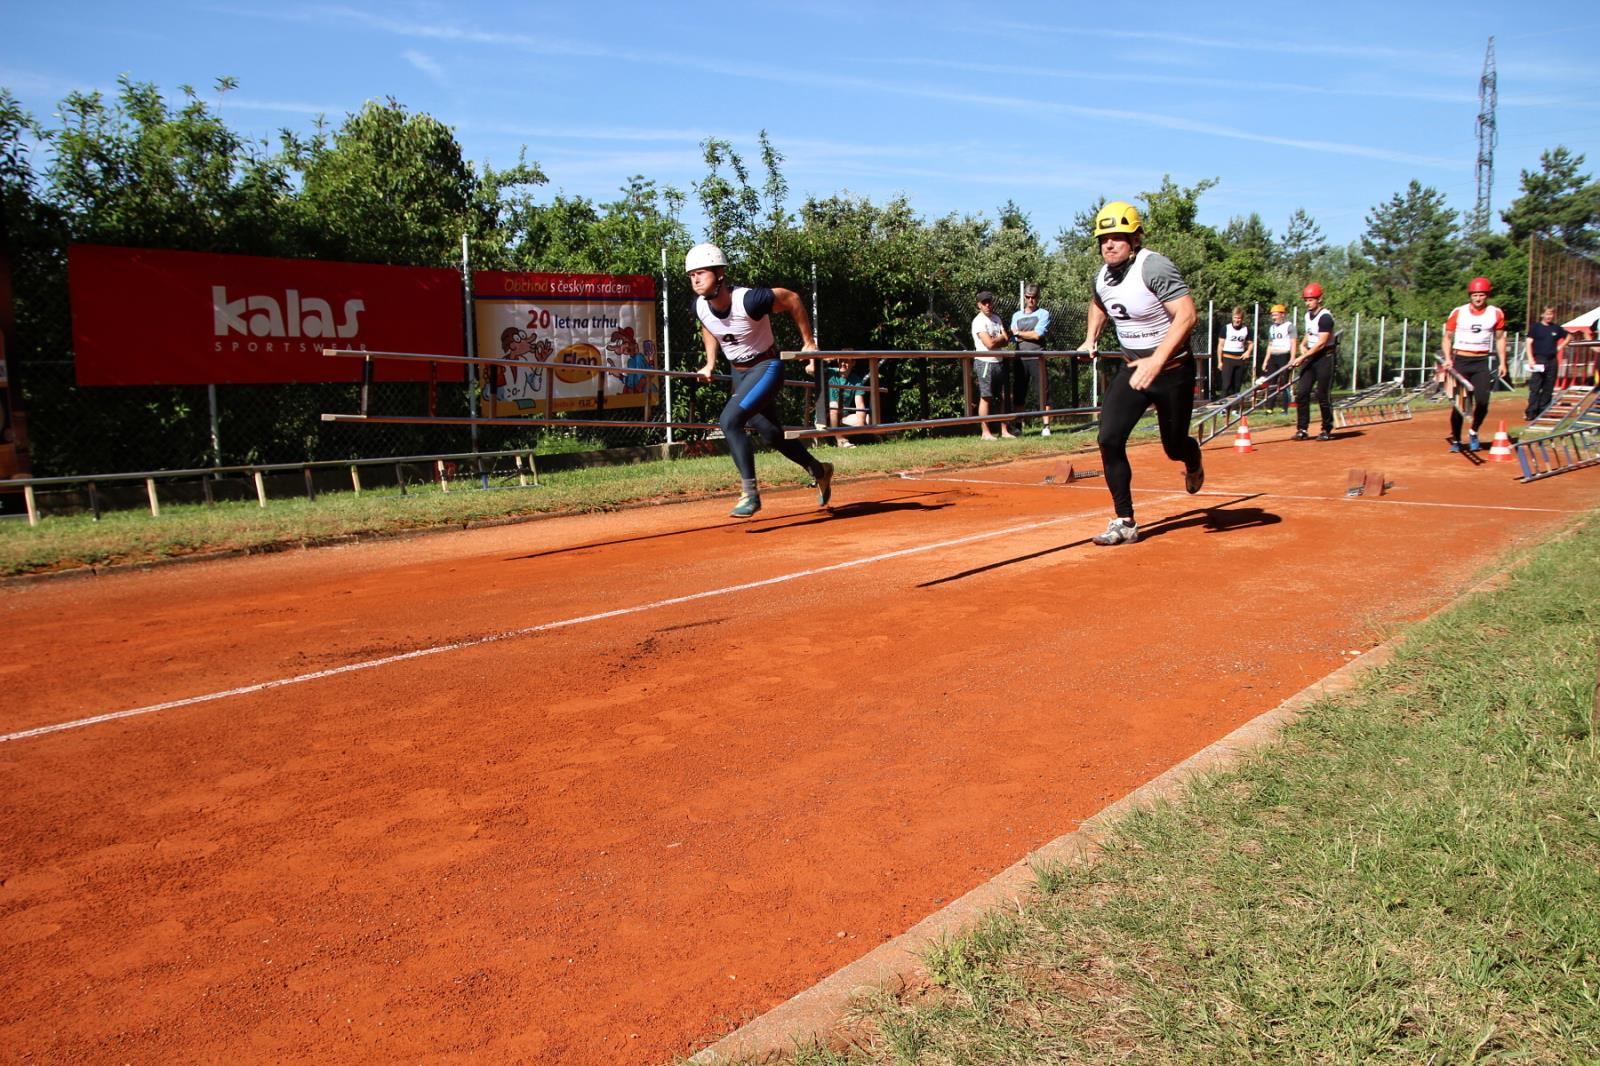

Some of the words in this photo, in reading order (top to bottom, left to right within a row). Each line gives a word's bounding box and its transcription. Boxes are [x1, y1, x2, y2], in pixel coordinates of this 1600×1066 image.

[504, 279, 548, 293] Obchod
[550, 282, 555, 293] s
[557, 280, 595, 295] českým
[596, 281, 631, 294] srdcem
[212, 285, 365, 338] kalas
[526, 309, 551, 329] 20
[554, 314, 571, 329] let
[572, 318, 589, 329] na
[592, 315, 618, 329] trhu
[1471, 323, 1482, 334] 5
